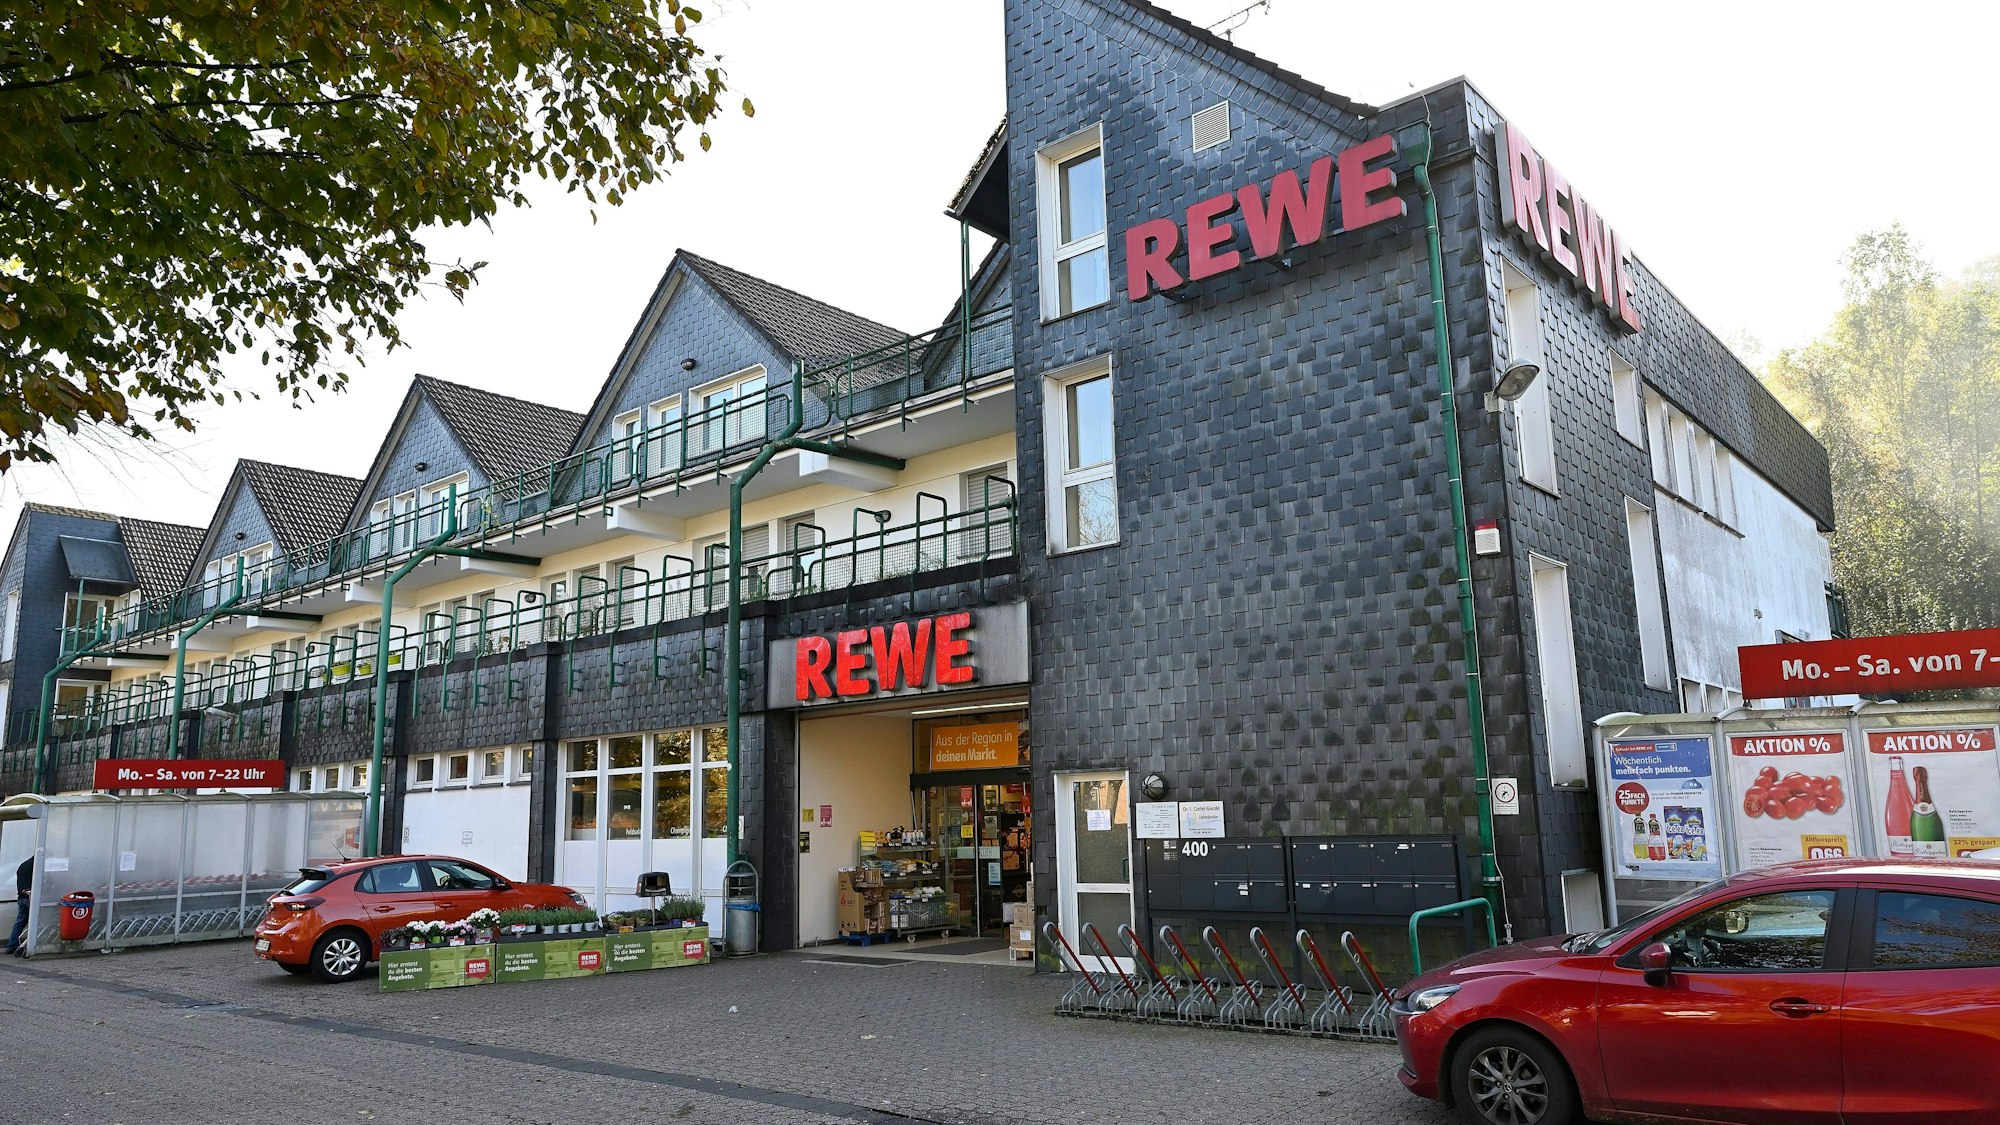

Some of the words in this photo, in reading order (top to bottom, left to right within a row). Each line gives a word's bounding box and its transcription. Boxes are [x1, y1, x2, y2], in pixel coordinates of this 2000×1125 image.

[1125, 135, 1406, 301] REWE
[1497, 121, 1641, 334] REWE
[796, 611, 977, 701] REWE
[1782, 659, 1830, 681] Mo.
[1857, 654, 1901, 676] Sa.
[1908, 652, 1962, 673] von
[936, 733, 953, 747] Aus
[956, 733, 970, 746] der
[972, 731, 1002, 747] Region
[1004, 729, 1013, 742] in
[1744, 736, 1806, 754] AKTION
[1808, 736, 1831, 753] %
[1883, 734, 1952, 752] AKTION
[1956, 732, 1982, 750] %
[936, 749, 967, 763] deinen
[967, 747, 998, 761] Markt.
[1614, 756, 1662, 766] Wöchentlich
[118, 768, 143, 780] Mo.
[156, 768, 177, 780] Sa.
[181, 770, 205, 780] von
[208, 769, 240, 780] 7–22
[243, 768, 266, 780] Uhr
[1615, 766, 1654, 775] mehrfach
[1654, 765, 1692, 775] punkten.
[1181, 841, 1209, 857] 400
[1970, 839, 1996, 847] gespart
[504, 965, 531, 973] Angebote.
